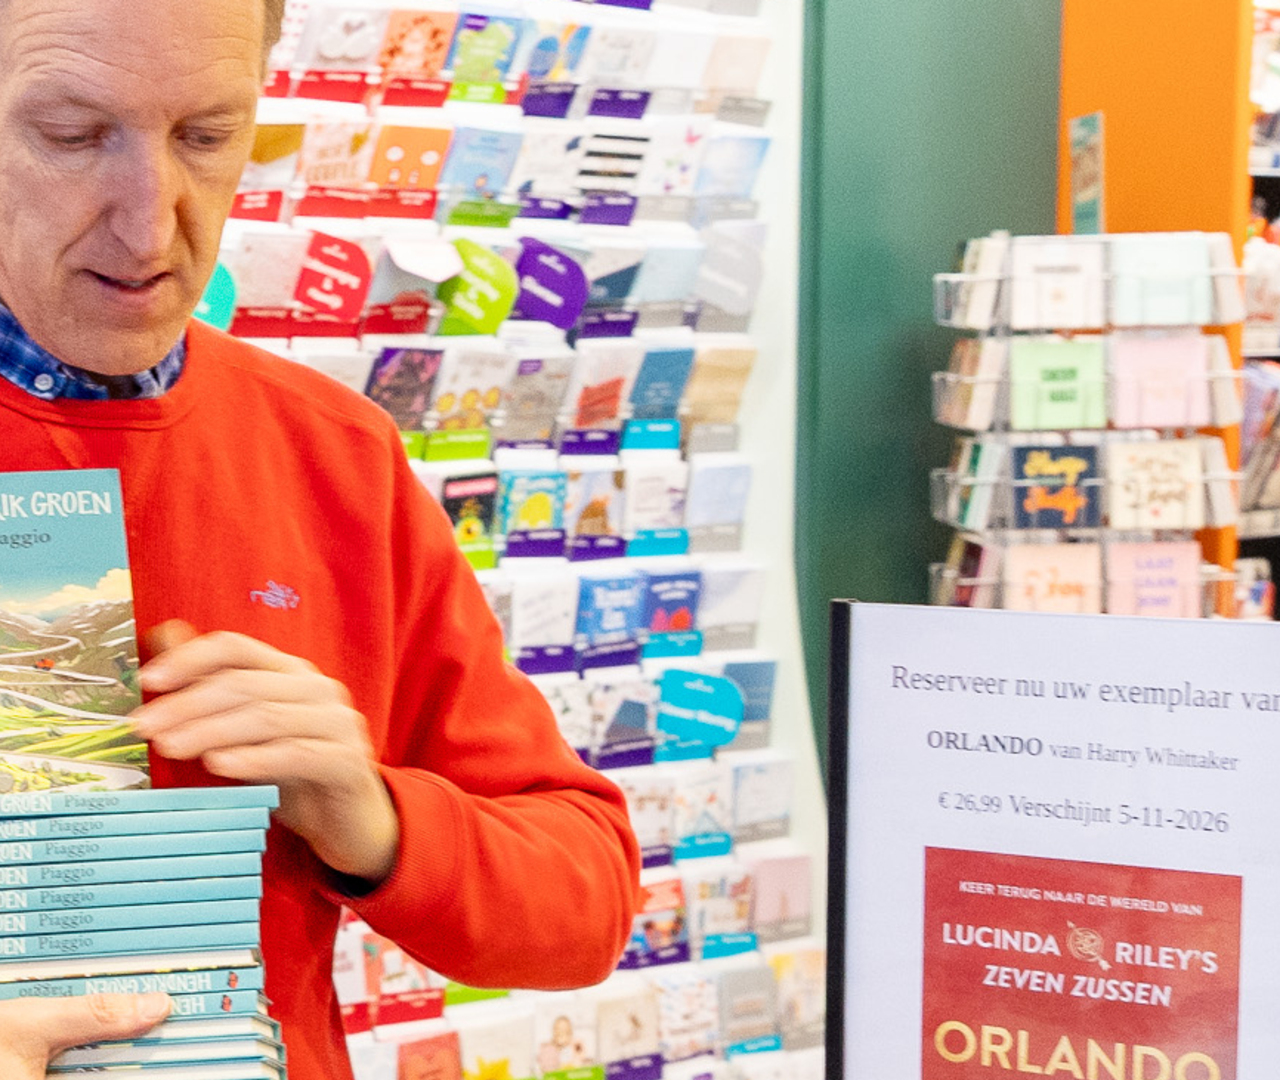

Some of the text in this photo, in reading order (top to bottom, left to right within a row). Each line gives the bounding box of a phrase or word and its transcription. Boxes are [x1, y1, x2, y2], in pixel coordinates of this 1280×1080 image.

[31, 490, 112, 518] GROEN
[891, 665, 1007, 696] Reserveer
[1015, 678, 1045, 698] nu
[1054, 681, 1091, 700] uw
[1099, 682, 1233, 713] exemplaar
[927, 730, 1239, 771] ORLANDO van Harry Whittaker
[0, 795, 52, 814] GROEN
[64, 794, 119, 810] Piaggio
[938, 791, 1229, 834] € 26,99 Verschijnt 5-11-2026
[49, 817, 104, 834] Piaggio
[45, 841, 100, 858] Piaggio
[41, 865, 95, 882] Piaggio
[40, 889, 95, 906] Piaggio
[959, 881, 1203, 916] KEER TERUG NAAR DE WERELD VAN
[39, 912, 94, 930] Piaggio
[38, 936, 94, 953] Piaggio
[942, 922, 1219, 974] LUCINDA RILEY'S
[142, 972, 212, 994] HENDRIK
[983, 965, 1172, 1007] ZEVEN ZUSSEN
